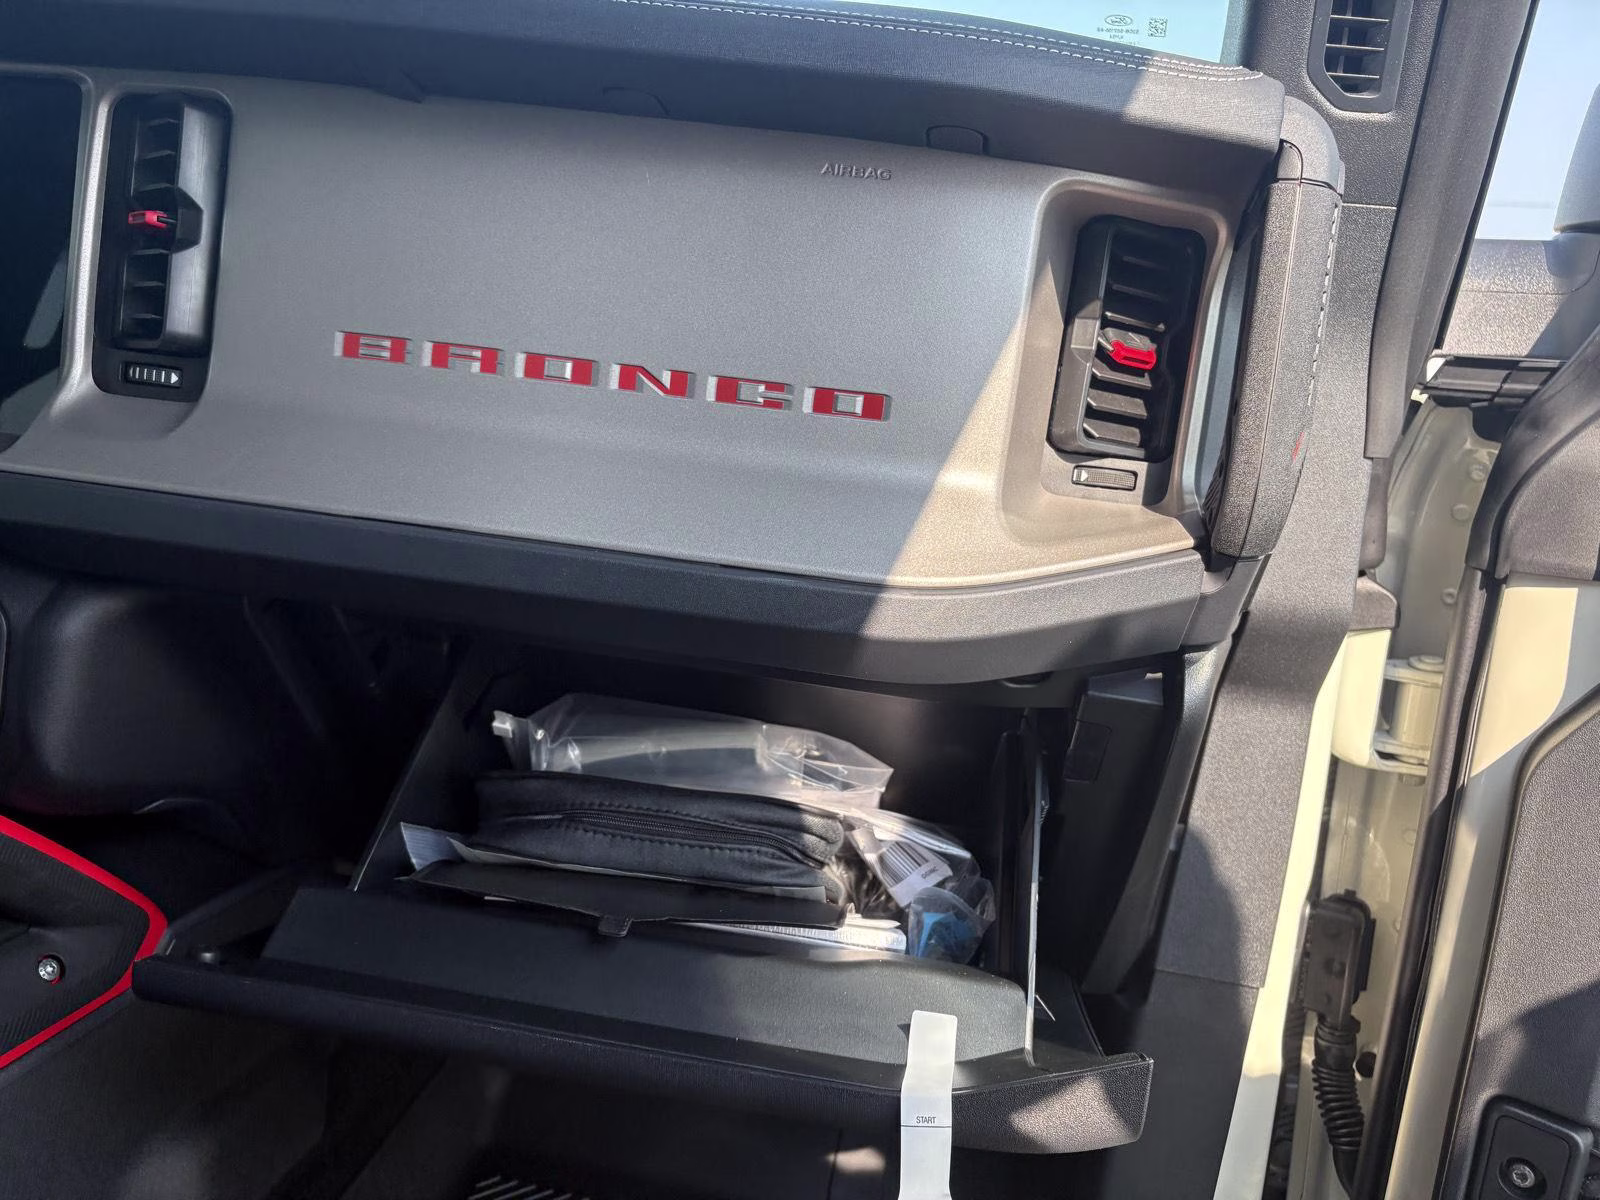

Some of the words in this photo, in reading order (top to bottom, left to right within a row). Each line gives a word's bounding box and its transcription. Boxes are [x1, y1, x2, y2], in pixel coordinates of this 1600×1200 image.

[821, 162, 892, 181] AIRBAG
[333, 330, 892, 422] BRONCO
[915, 1115, 937, 1125] START
